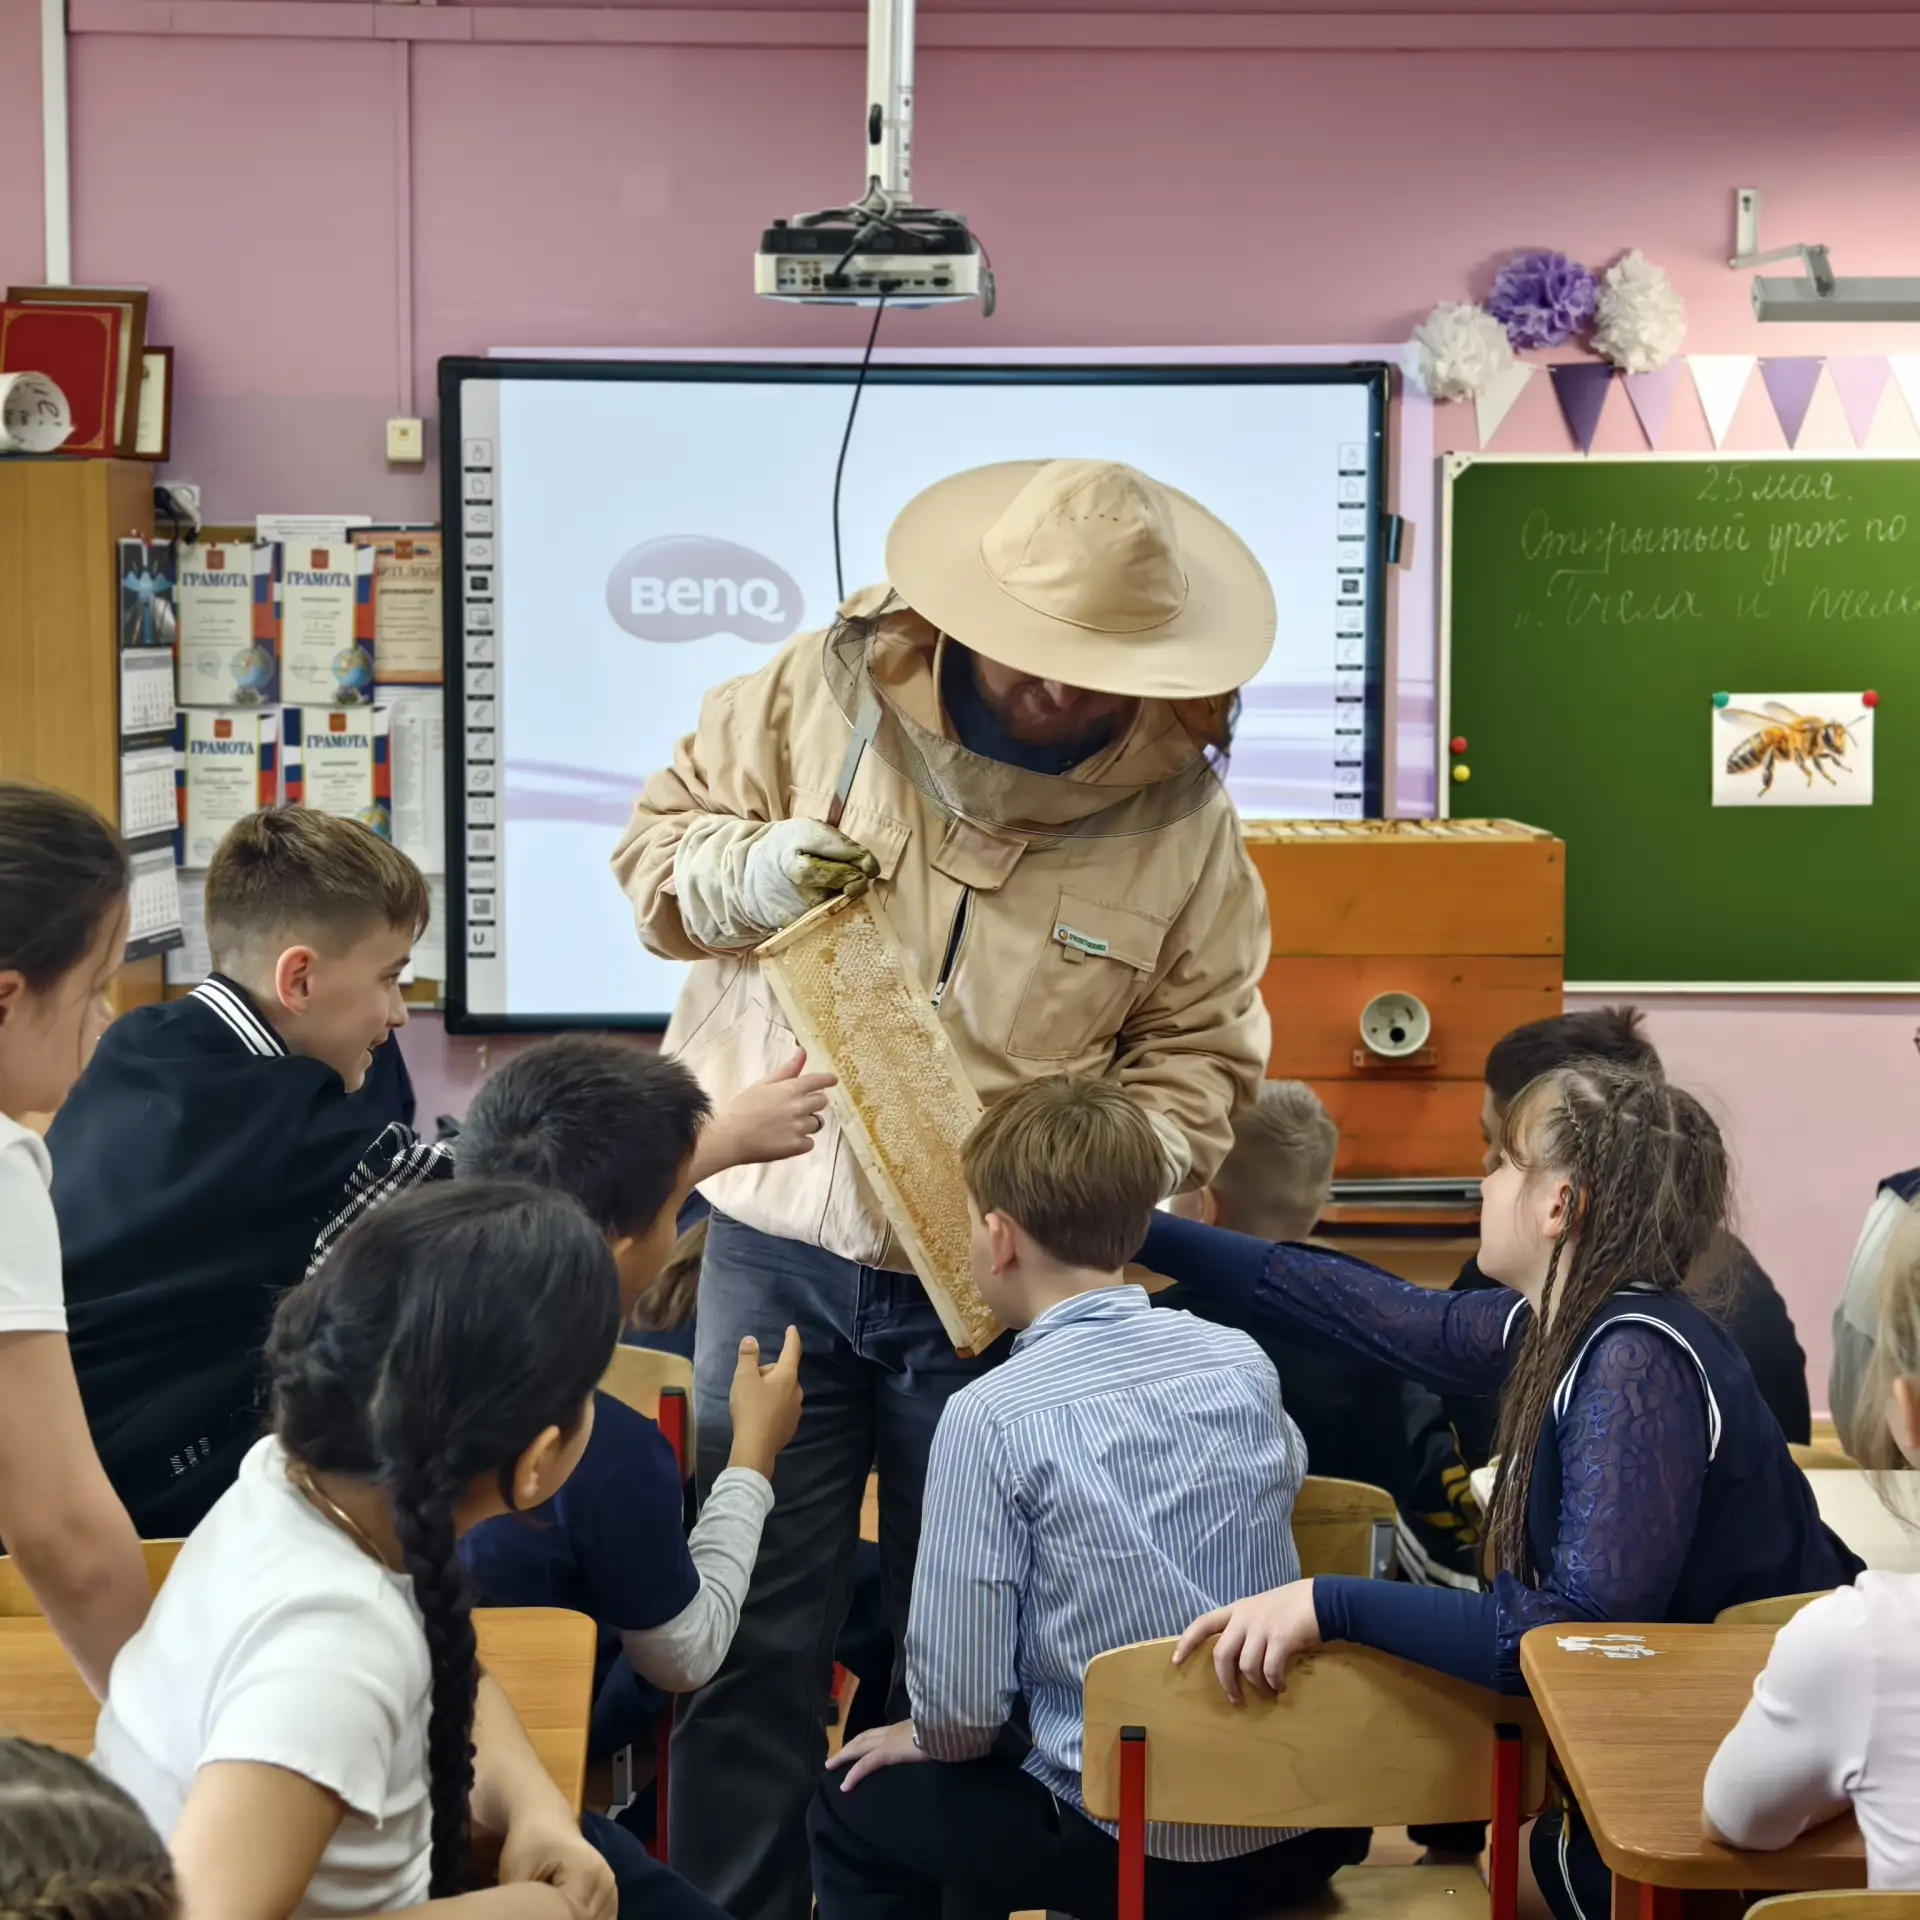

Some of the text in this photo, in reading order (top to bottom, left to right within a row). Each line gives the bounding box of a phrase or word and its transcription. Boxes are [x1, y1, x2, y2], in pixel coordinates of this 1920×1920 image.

[1696, 464, 1750, 502] 25
[1521, 508, 1907, 587] Открытый урок по
[182, 572, 248, 588] ГРАМОТА
[287, 570, 351, 588] ГРАМОТА
[631, 576, 786, 624] BenQ
[1736, 592, 1771, 619] и
[190, 740, 254, 755] ГРАМОТА
[306, 734, 369, 749] ГРАМОТА
